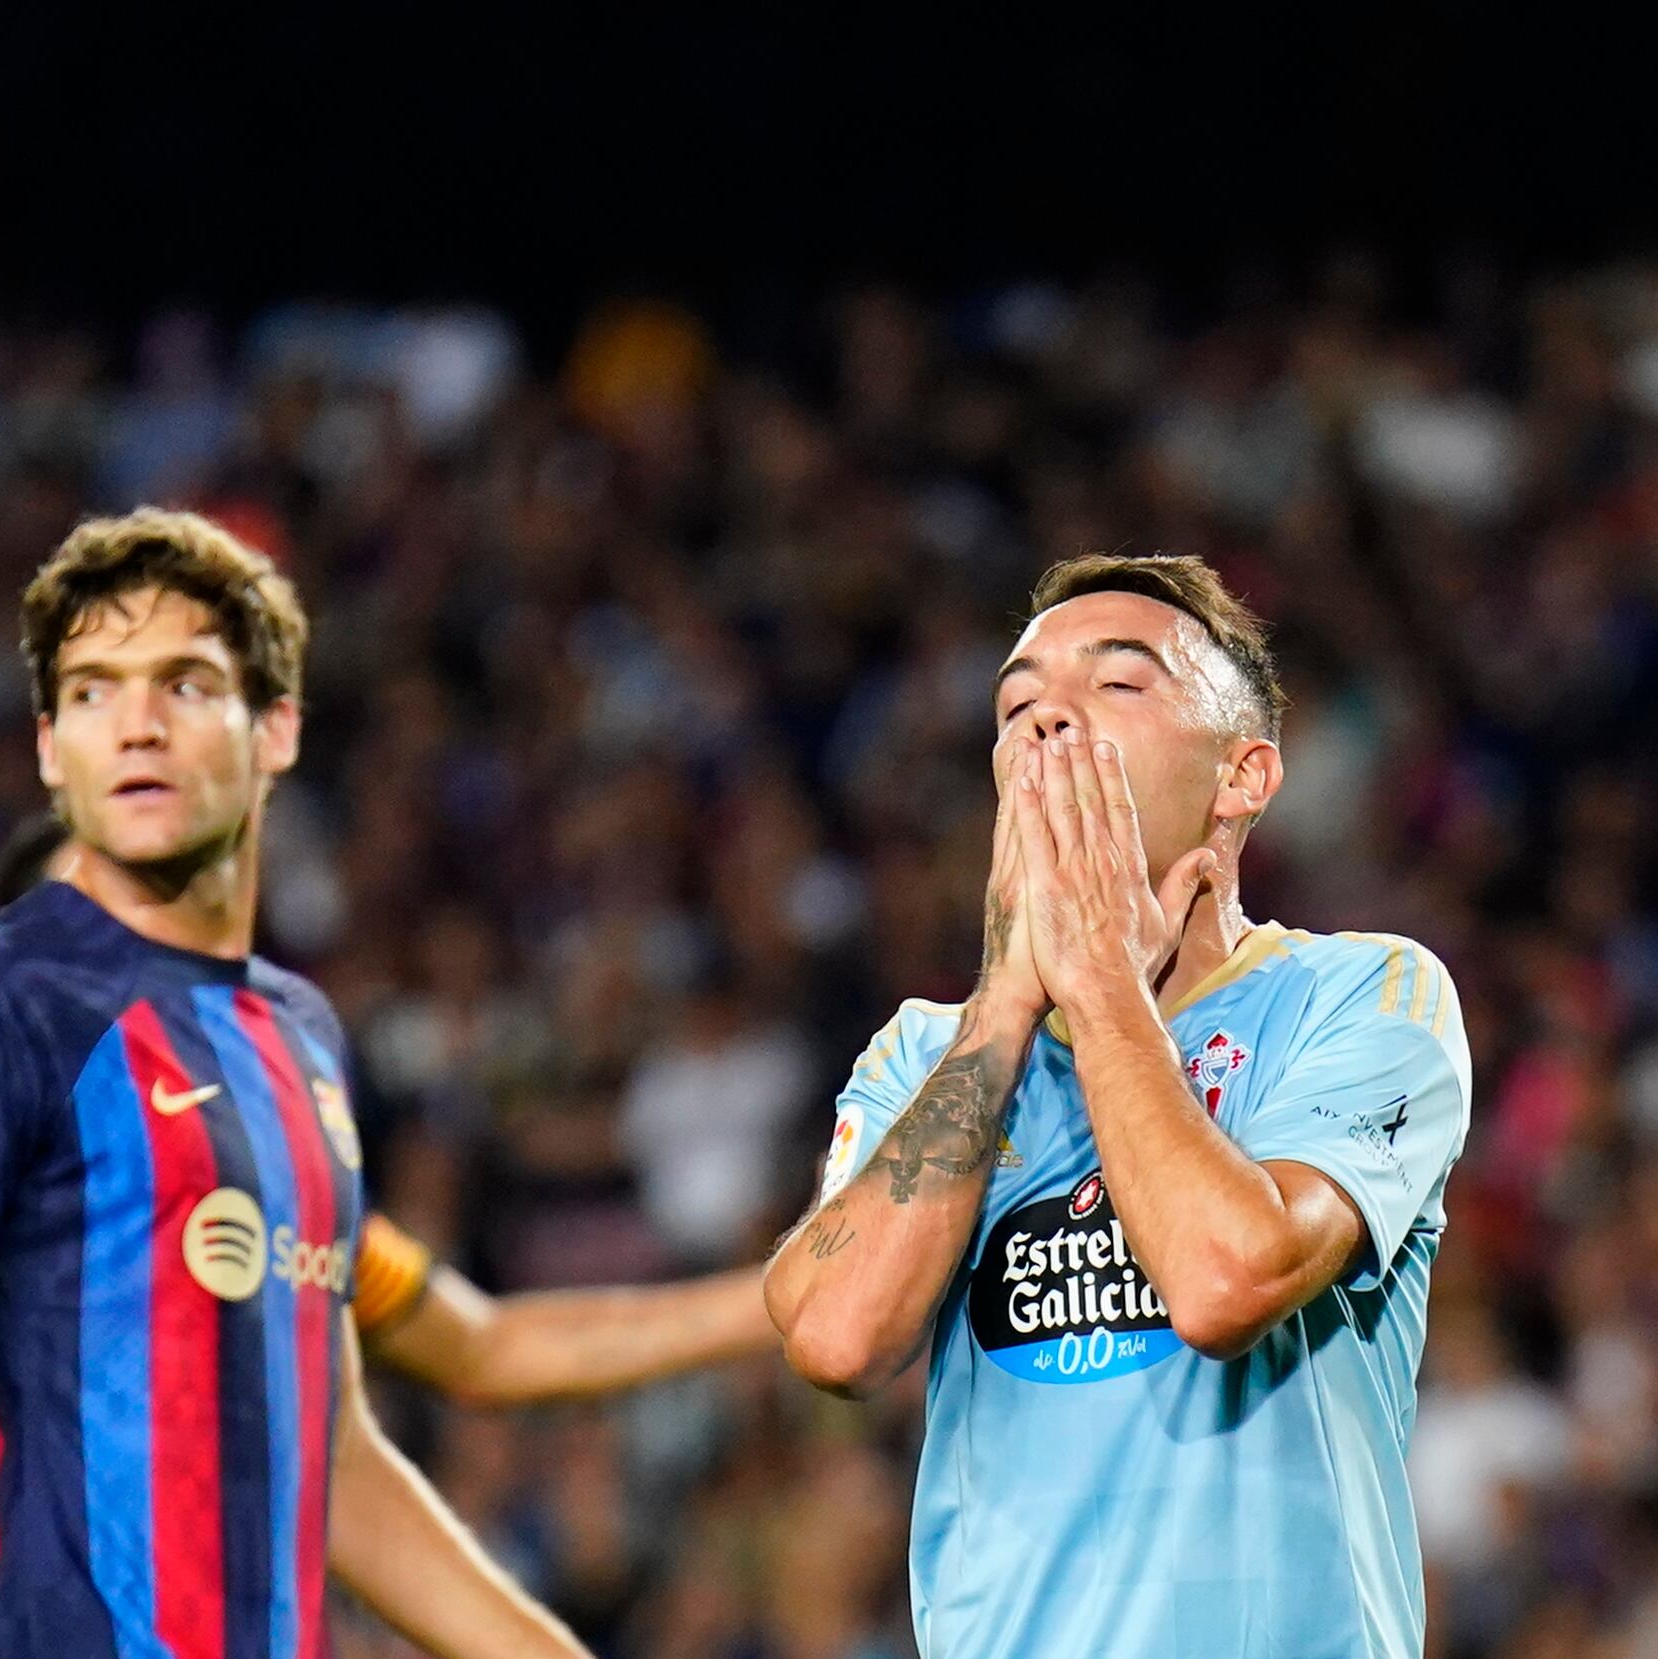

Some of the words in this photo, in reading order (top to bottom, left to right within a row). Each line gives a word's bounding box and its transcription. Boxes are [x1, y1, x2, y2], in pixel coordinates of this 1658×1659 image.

[272, 1222, 349, 1295] Spot
[1003, 1218, 1139, 1283] Estrel
[1008, 1268, 1170, 1334] Galicia
[1057, 1326, 1115, 1375] 0,0
